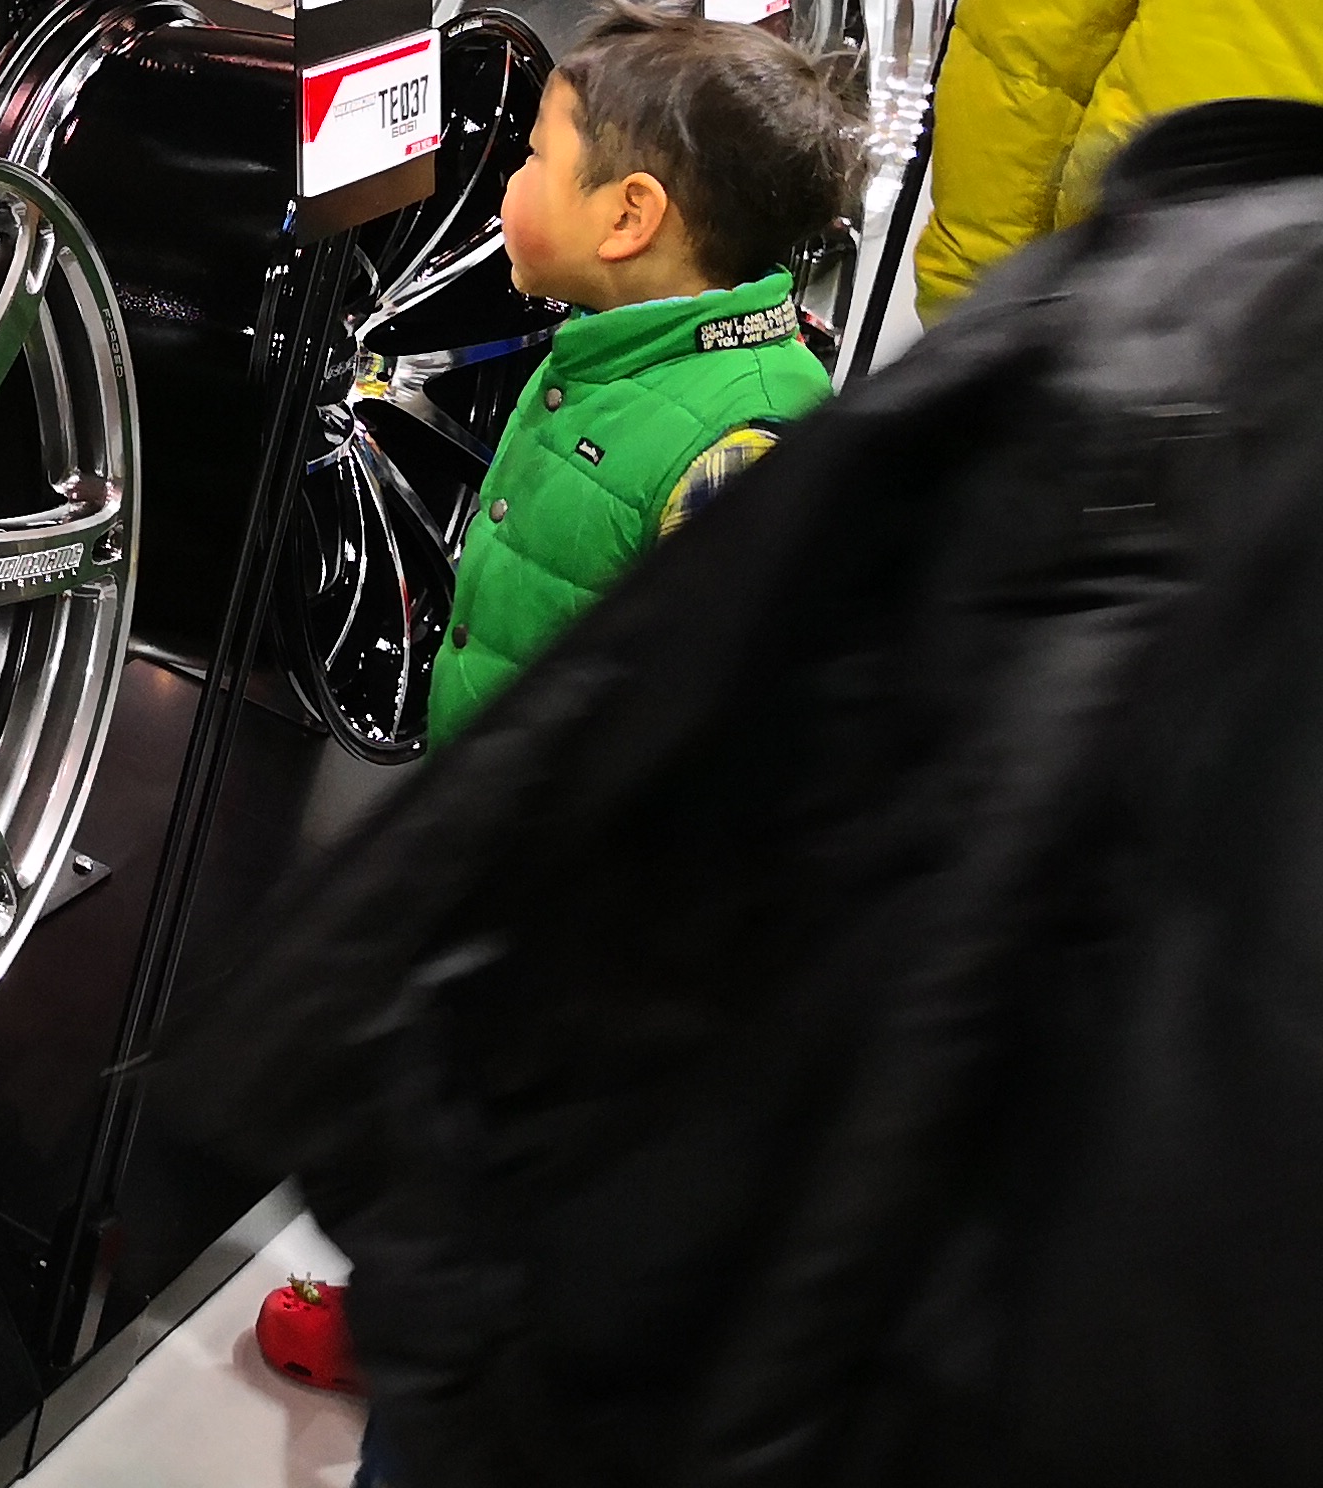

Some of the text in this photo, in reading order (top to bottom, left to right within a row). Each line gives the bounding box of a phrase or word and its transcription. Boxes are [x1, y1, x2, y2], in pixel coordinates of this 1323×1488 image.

[378, 74, 429, 129] TE037
[717, 335, 740, 348] YOU
[12, 543, 85, 581] RACING
